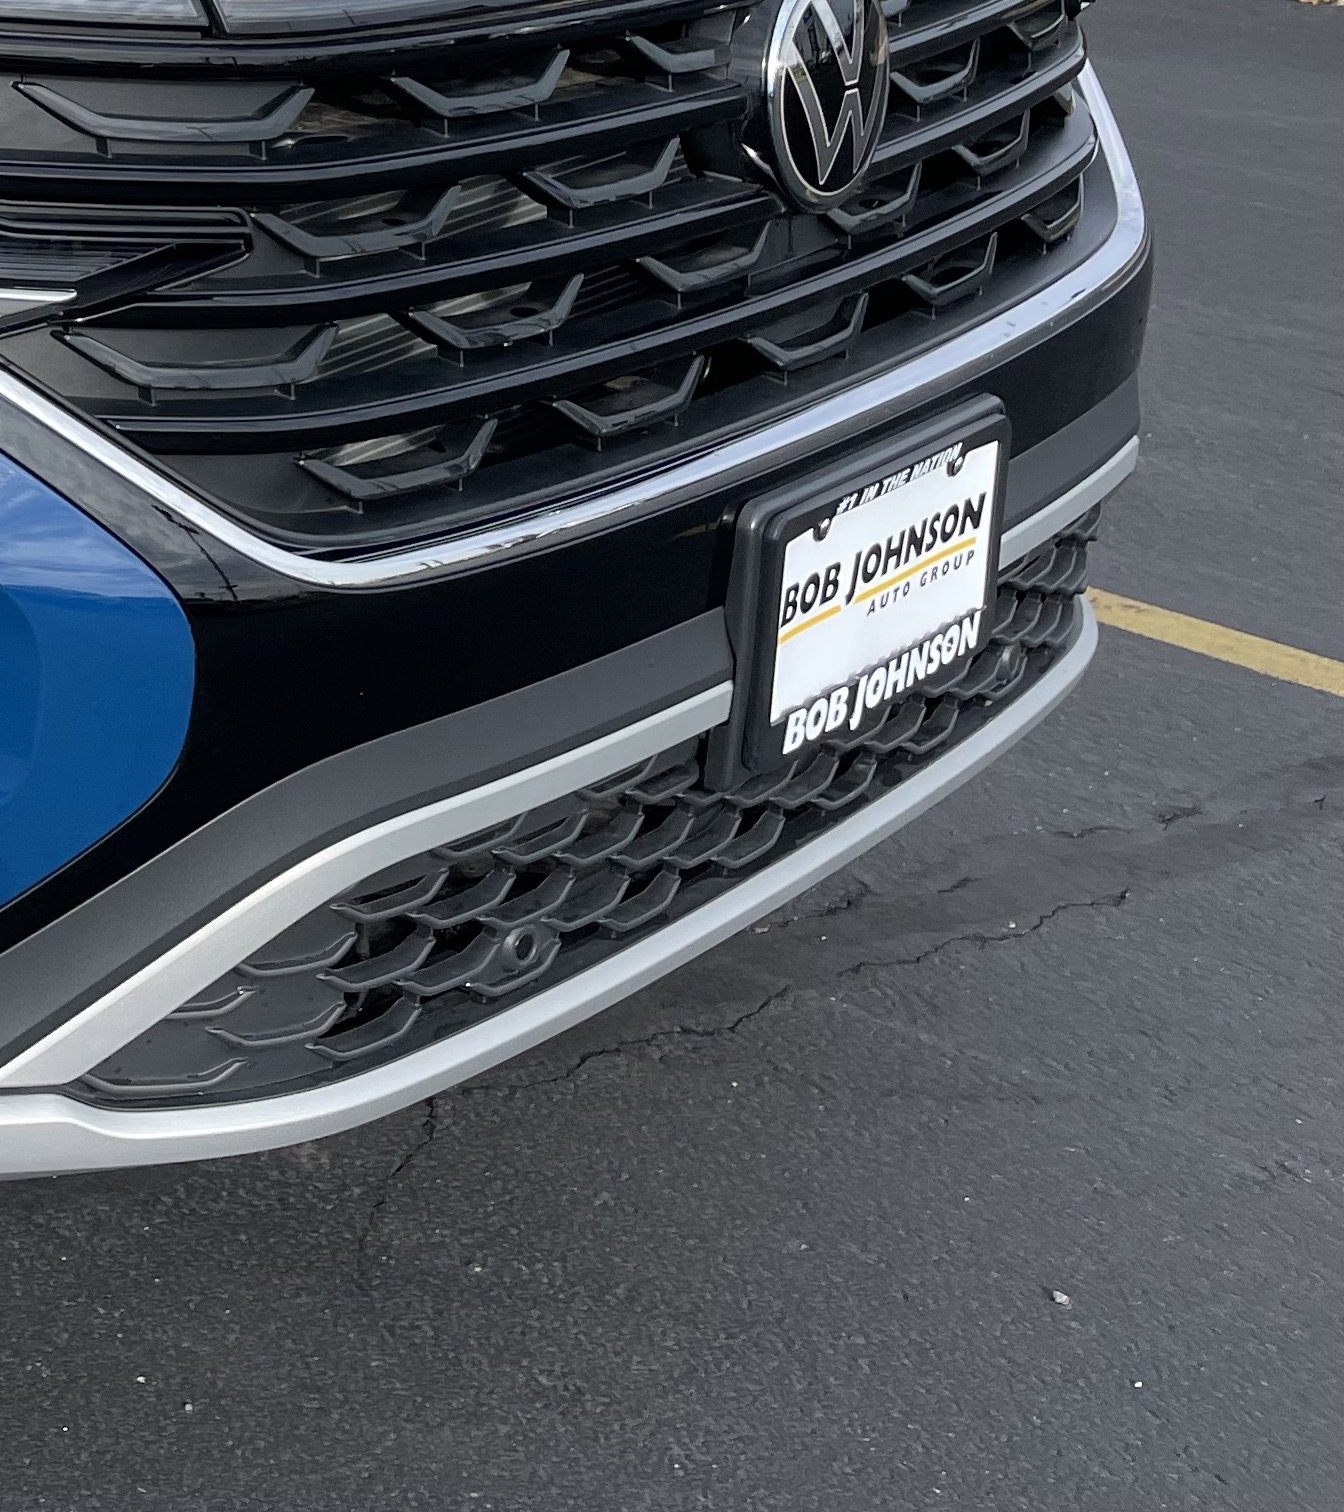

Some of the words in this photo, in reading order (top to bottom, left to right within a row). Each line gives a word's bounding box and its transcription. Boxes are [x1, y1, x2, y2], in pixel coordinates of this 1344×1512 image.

[836, 493, 859, 515] #1
[859, 482, 880, 506] IN
[880, 468, 911, 496] THE
[780, 562, 842, 628] BOB
[845, 492, 988, 605] JOHNSON
[866, 582, 911, 617] AUTO
[919, 549, 976, 588] GROUP
[782, 686, 850, 755] BOB
[848, 609, 982, 731] JOHNSON
